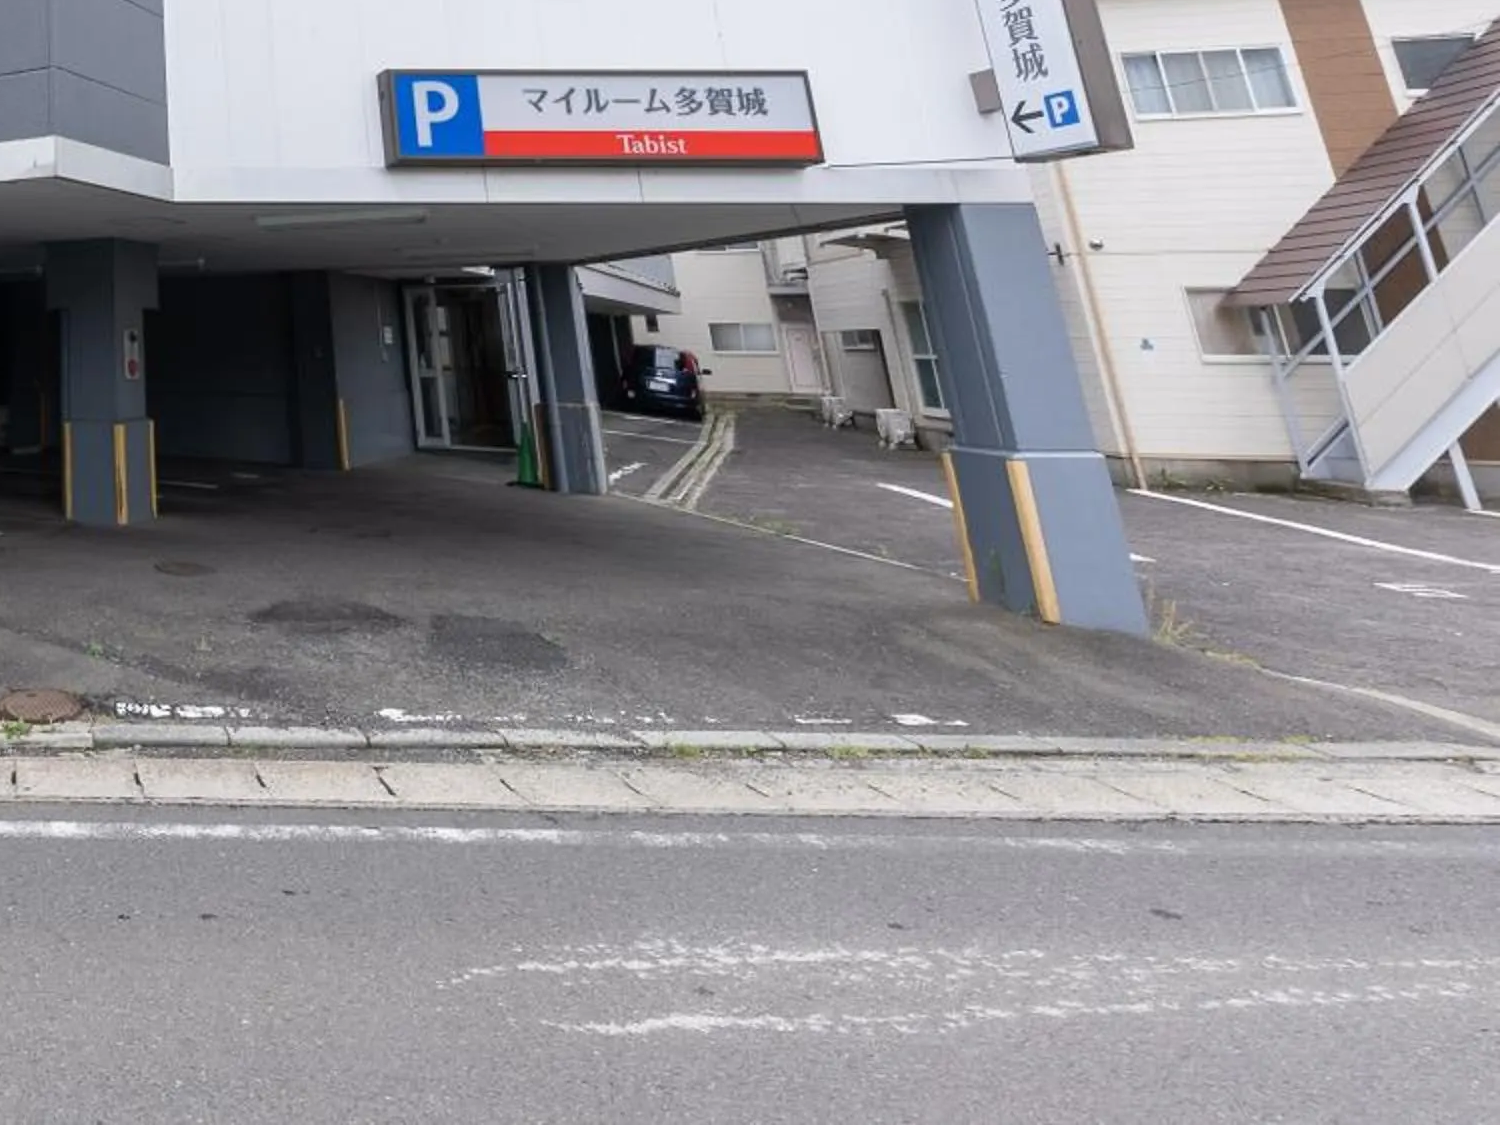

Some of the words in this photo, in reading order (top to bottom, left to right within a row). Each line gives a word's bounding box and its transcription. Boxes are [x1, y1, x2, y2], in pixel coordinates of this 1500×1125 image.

[411, 80, 460, 148] P
[522, 87, 769, 117] マイルーム多賀城
[1051, 97, 1071, 124] P
[615, 134, 689, 155] Tabist
